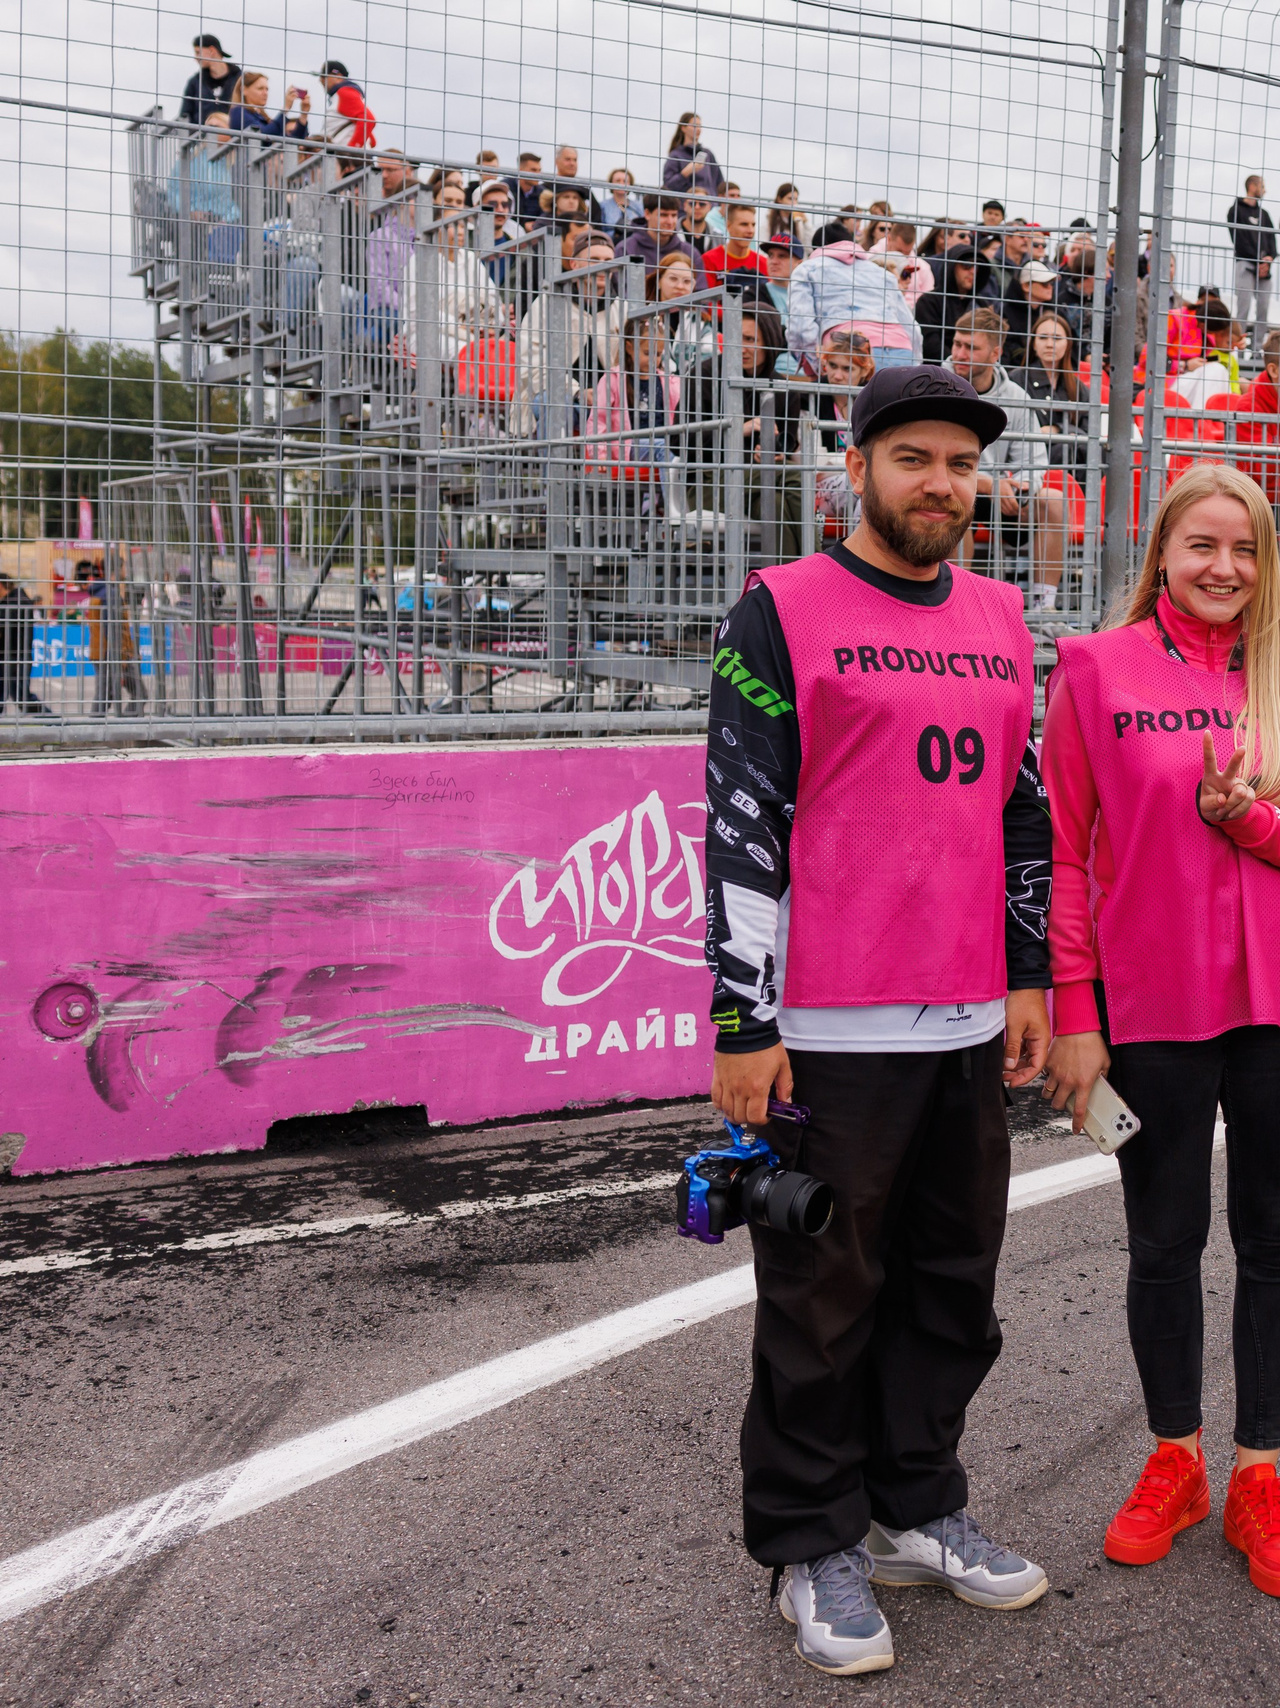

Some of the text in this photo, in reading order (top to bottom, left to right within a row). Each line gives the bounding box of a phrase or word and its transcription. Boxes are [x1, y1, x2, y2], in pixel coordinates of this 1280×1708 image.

[833, 645, 1020, 686] PRODUCTION
[917, 725, 985, 785] 09
[426, 770, 457, 787] был
[1019, 762, 1038, 785] THENA
[733, 793, 759, 814] GET
[716, 816, 740, 838] DP
[525, 1008, 697, 1062] ДРАЙВ
